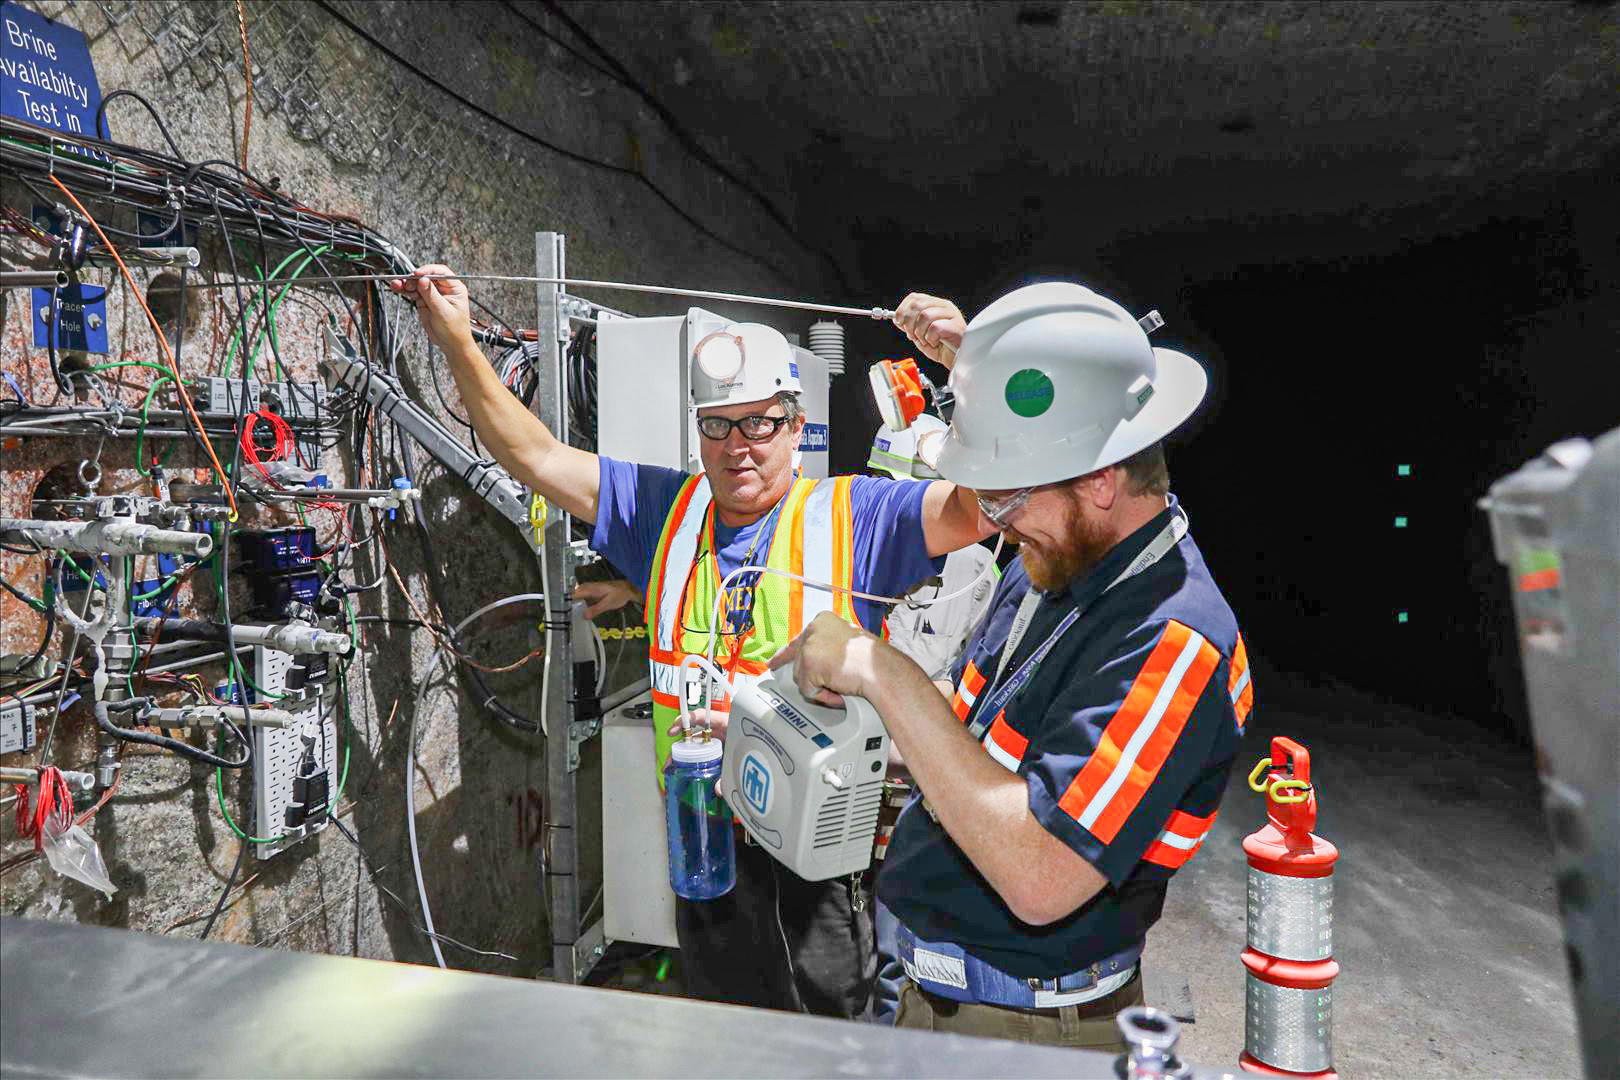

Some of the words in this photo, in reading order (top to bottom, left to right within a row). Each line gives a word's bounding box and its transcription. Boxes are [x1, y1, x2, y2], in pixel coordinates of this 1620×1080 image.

[6, 18, 57, 61] Brine
[17, 89, 61, 127] Test
[64, 105, 82, 134] in
[60, 319, 81, 333] Hole
[770, 697, 808, 729] GEMINI
